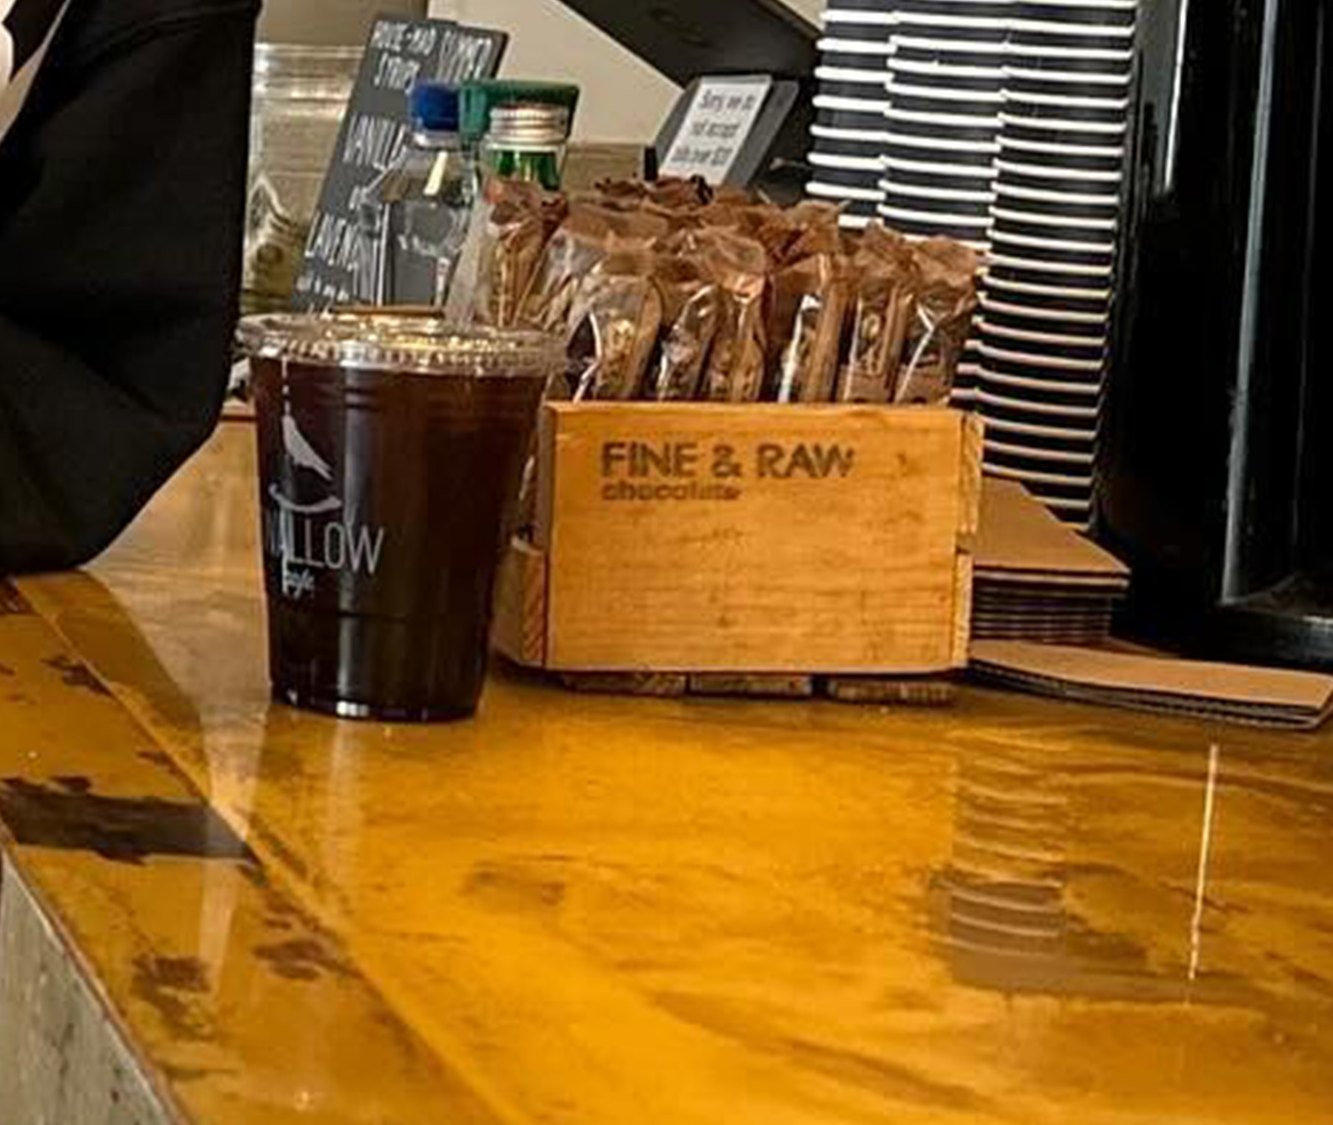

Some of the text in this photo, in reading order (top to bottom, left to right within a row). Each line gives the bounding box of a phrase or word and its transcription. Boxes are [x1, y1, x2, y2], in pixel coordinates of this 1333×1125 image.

[602, 442, 855, 478] FINE & RAW
